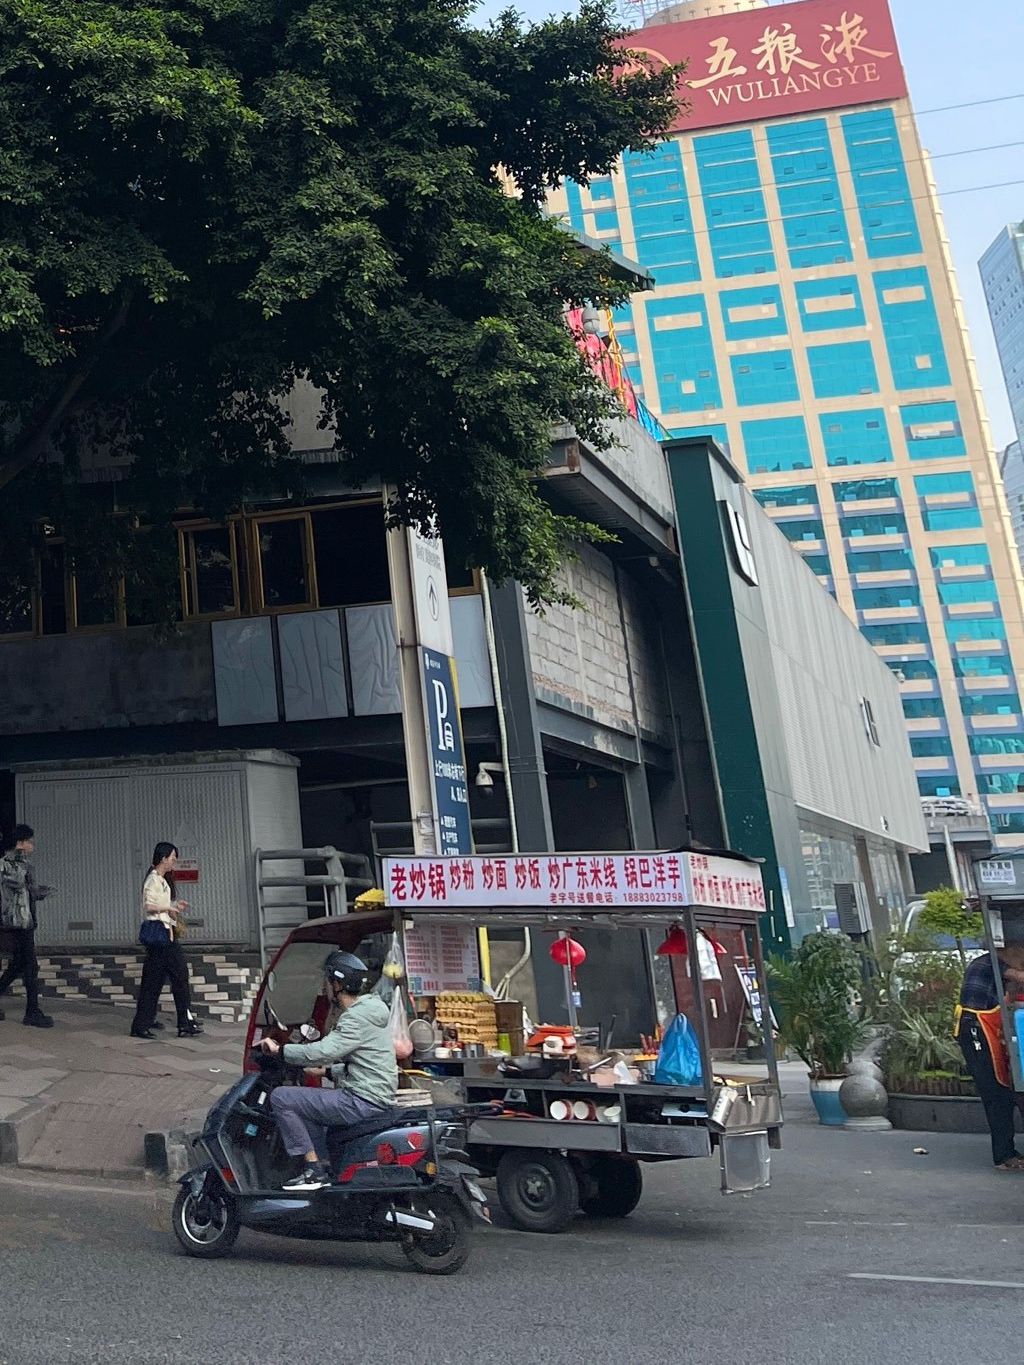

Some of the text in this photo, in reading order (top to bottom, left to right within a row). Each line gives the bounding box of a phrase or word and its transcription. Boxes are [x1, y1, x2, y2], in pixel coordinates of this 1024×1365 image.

[684, 10, 893, 90] 五粮液
[707, 61, 881, 107] WULIANGYE
[391, 856, 680, 900] 老炒锅 炒粉 炒面 炒饭 炒广东米线 锅巴洋芋
[623, 892, 683, 903] 18883023798
